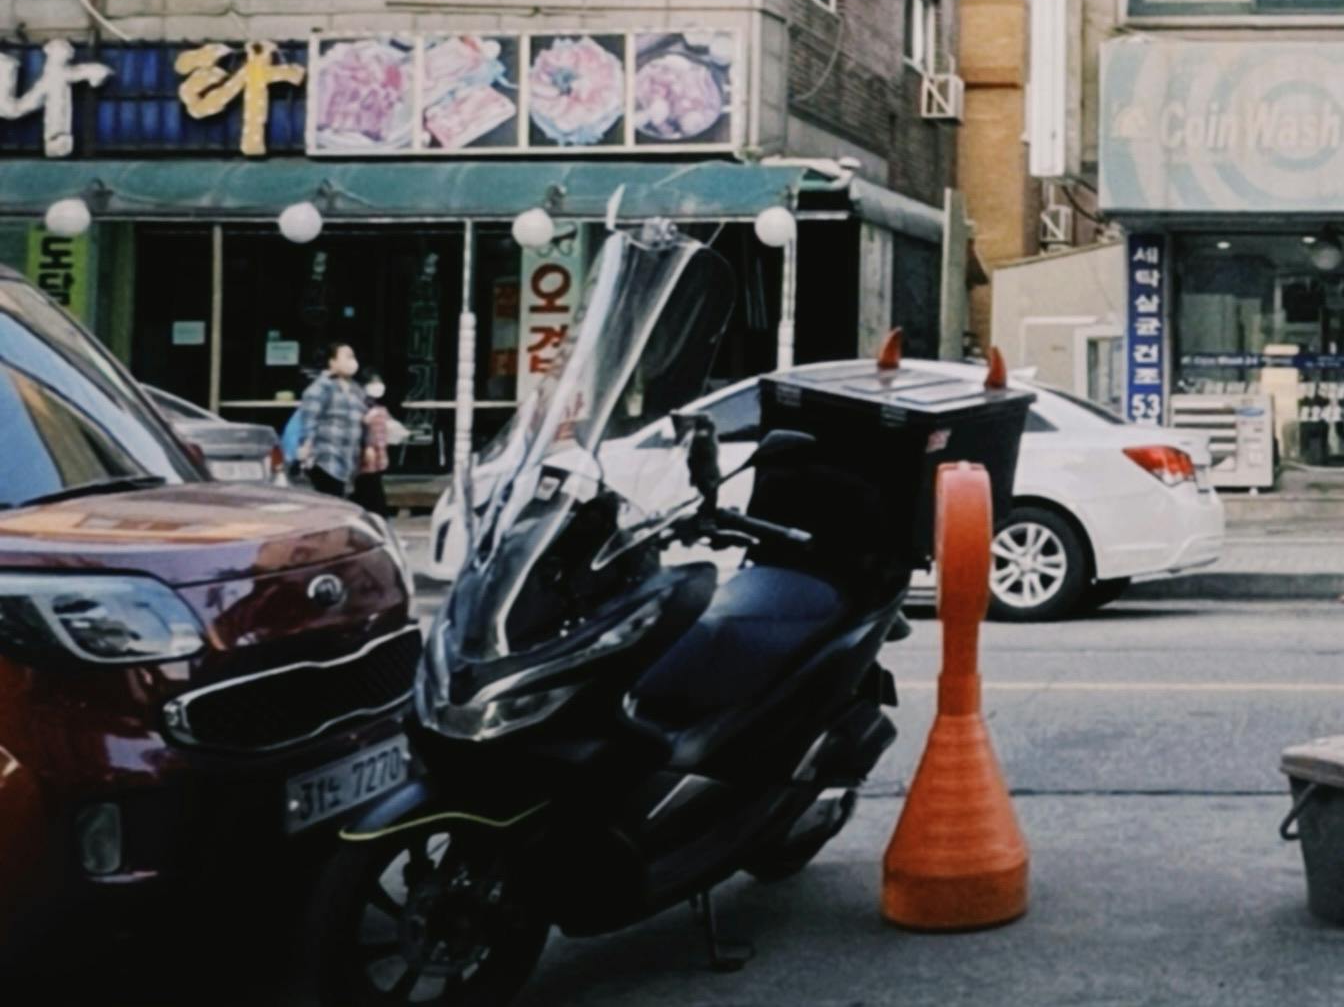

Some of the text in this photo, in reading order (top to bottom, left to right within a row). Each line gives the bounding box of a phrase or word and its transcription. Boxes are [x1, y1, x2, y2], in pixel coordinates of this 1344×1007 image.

[1161, 100, 1238, 150] Coin
[1246, 99, 1342, 149] Wash
[352, 745, 400, 799] 7270
